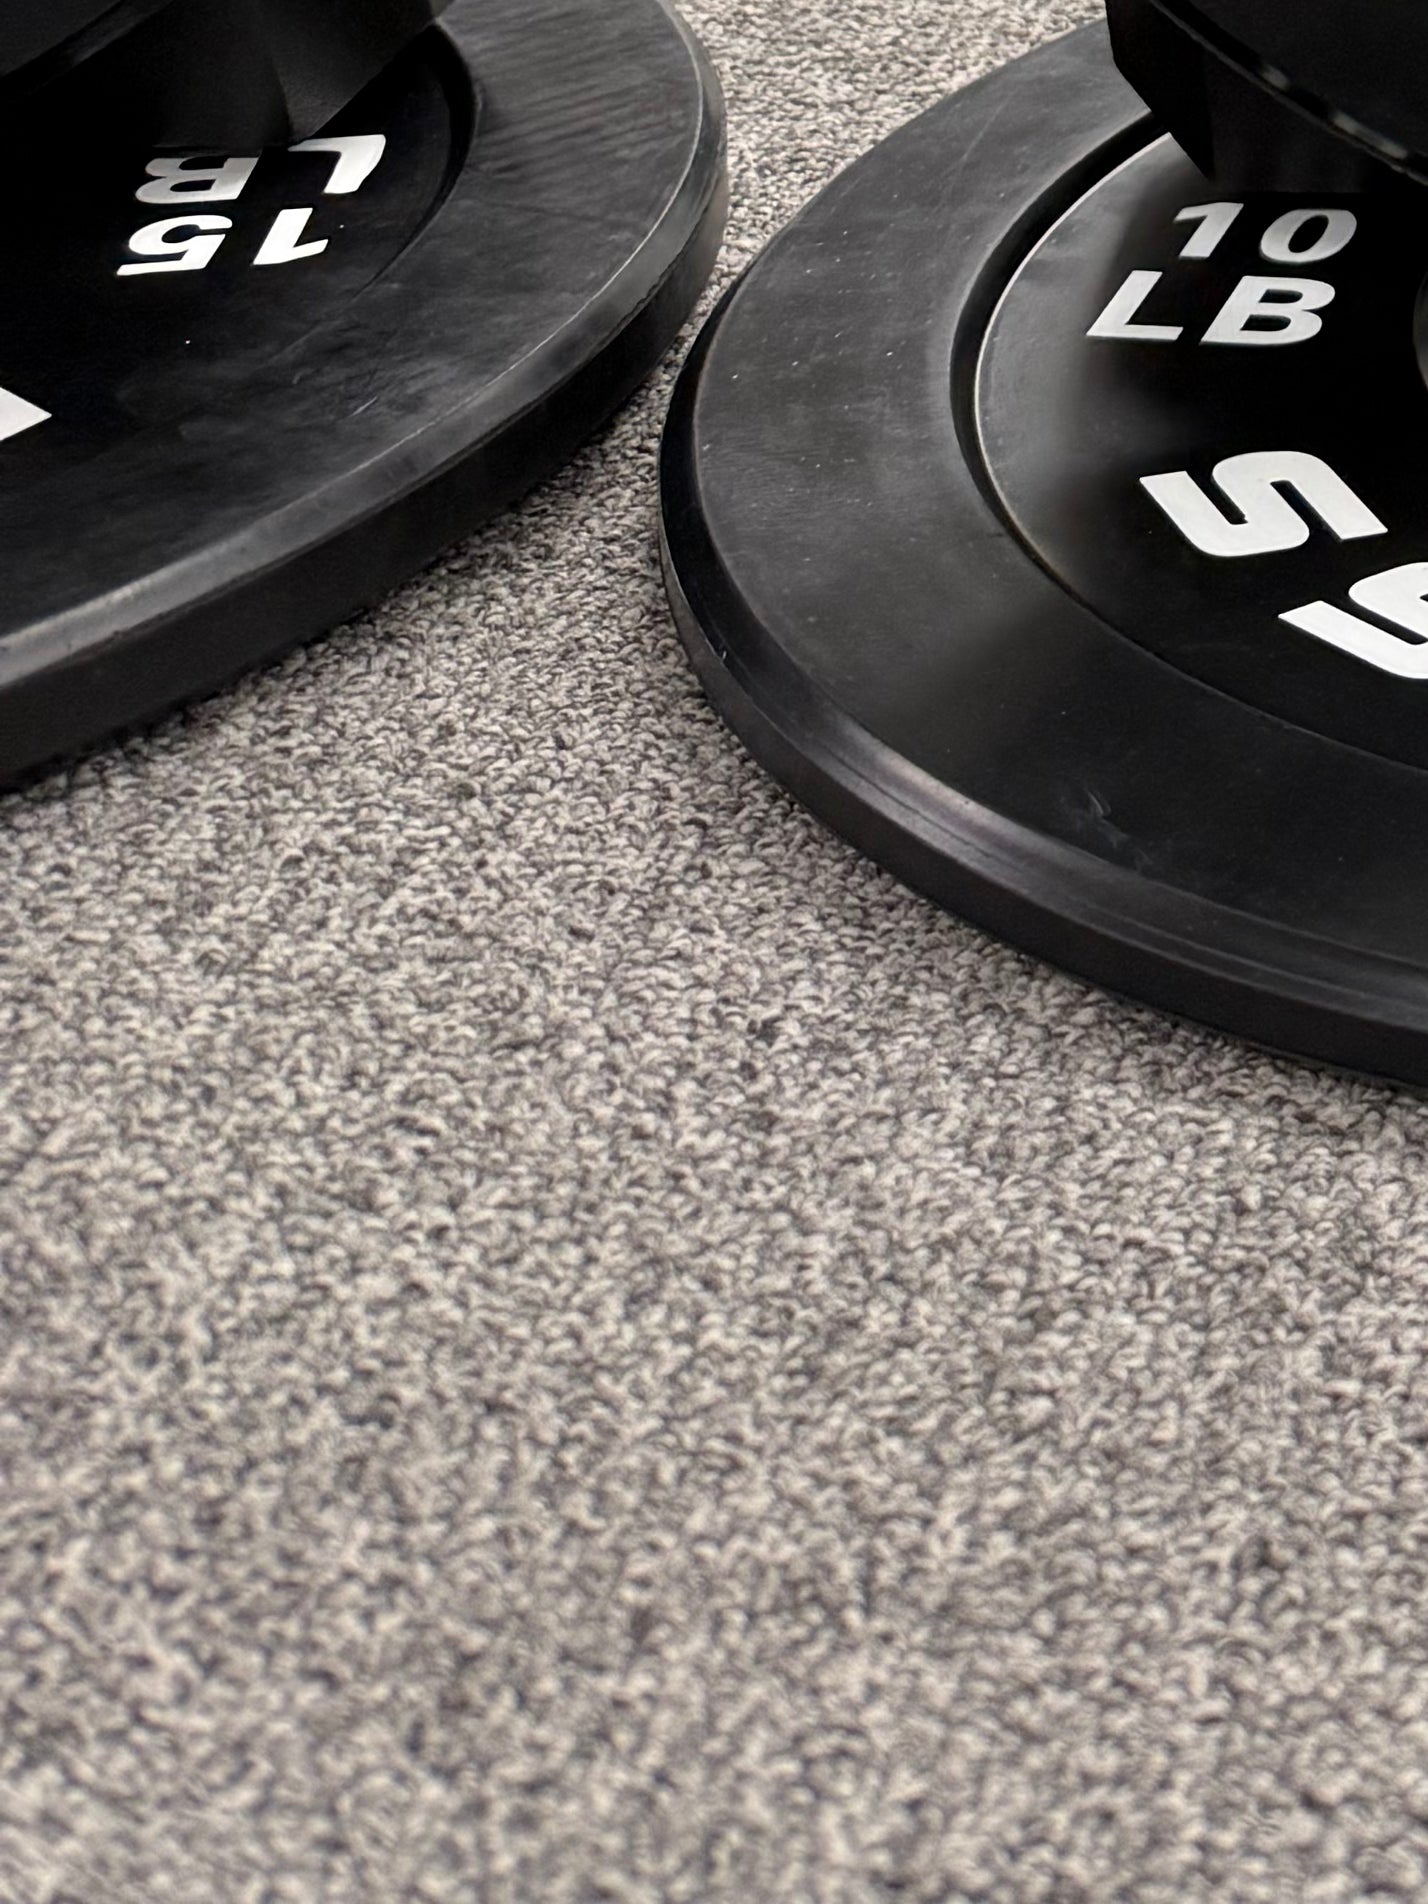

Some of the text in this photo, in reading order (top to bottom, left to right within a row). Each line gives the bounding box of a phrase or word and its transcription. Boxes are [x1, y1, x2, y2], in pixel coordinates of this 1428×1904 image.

[116, 207, 329, 276] 15
[1176, 202, 1355, 266] 10
[1085, 270, 1336, 345] LB
